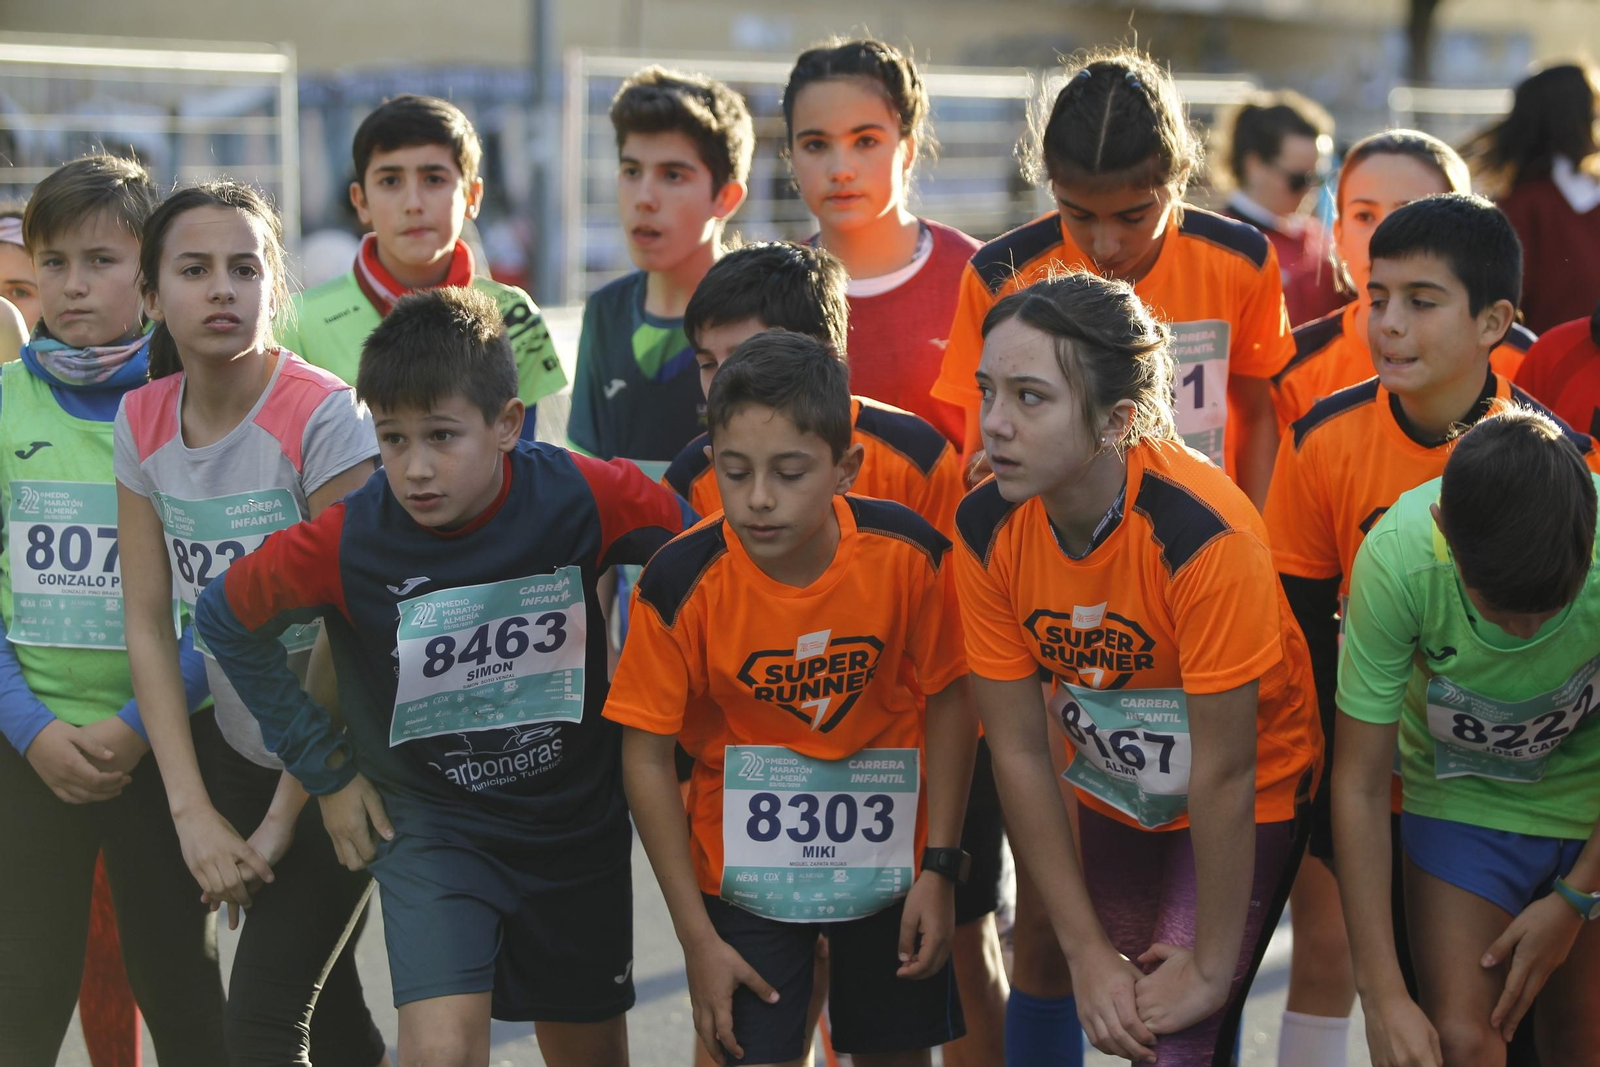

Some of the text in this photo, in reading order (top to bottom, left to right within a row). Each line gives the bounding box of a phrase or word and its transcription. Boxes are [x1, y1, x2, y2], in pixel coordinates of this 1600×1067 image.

[1173, 330, 1217, 343] ARRERA
[45, 491, 70, 499] MEDIO
[44, 499, 83, 508] MARATÓN
[225, 499, 283, 516] CARRERA
[44, 507, 78, 515] ALMERÍA
[230, 512, 286, 529] INFANTIL
[38, 573, 106, 587] GONZALO
[441, 599, 470, 609] MEDIO
[442, 603, 484, 617] MARATÓN
[443, 612, 480, 626] ALMERÍA
[422, 611, 568, 679] 8463
[1046, 626, 1134, 652] SUPER
[1040, 642, 1156, 671] RUNNER
[466, 661, 514, 682] SIMON
[764, 650, 869, 685] SUPER
[462, 681, 479, 689] SIMON
[480, 677, 495, 685] SOTO
[1120, 698, 1179, 709] CARRERA
[1126, 711, 1181, 723] INFANTIL
[1061, 701, 1176, 775] 8167
[428, 738, 563, 786] arboneras
[771, 758, 798, 766] MEDIO
[848, 760, 905, 770] CARRERA
[770, 765, 813, 774] MARATÓN
[769, 774, 808, 783] ALMERÍA
[850, 773, 905, 784] INFANTIL
[746, 792, 895, 844] 8303
[802, 845, 836, 858] MIKI
[735, 873, 758, 882] NEXA
[763, 872, 780, 882] CDX
